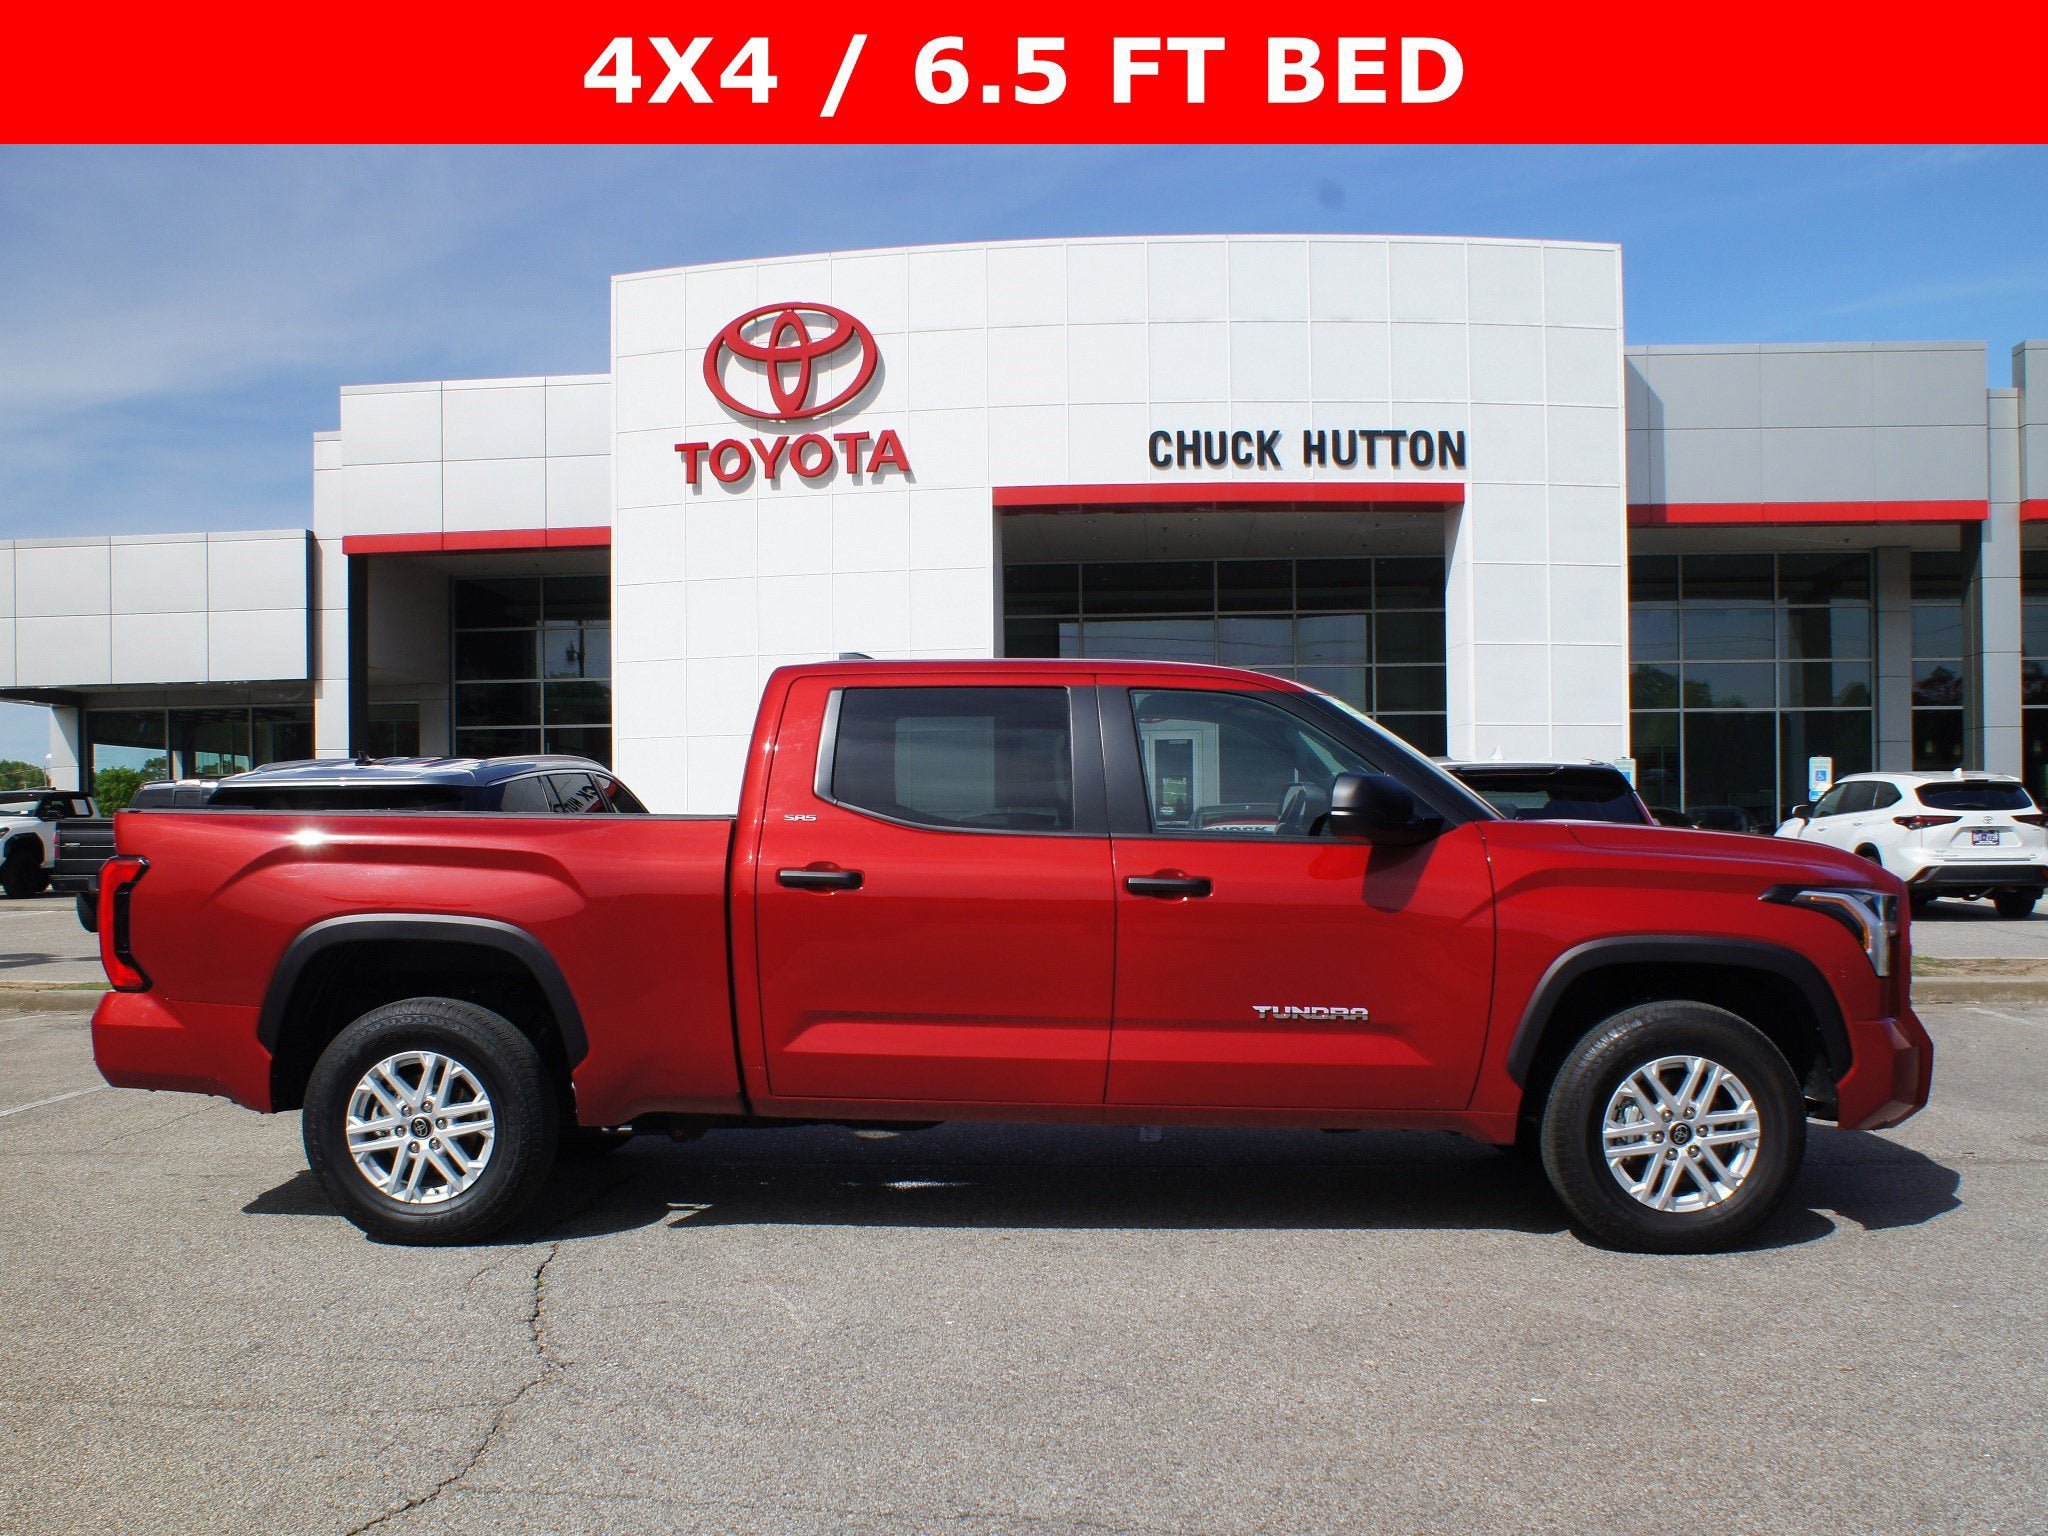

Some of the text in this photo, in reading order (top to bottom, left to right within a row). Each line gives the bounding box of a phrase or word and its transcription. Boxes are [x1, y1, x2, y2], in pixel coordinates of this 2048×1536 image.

[674, 429, 911, 485] TOYOTA
[1148, 429, 1466, 468] CHUCK HUTTON
[1251, 1005, 1369, 1021] TUNDRA
